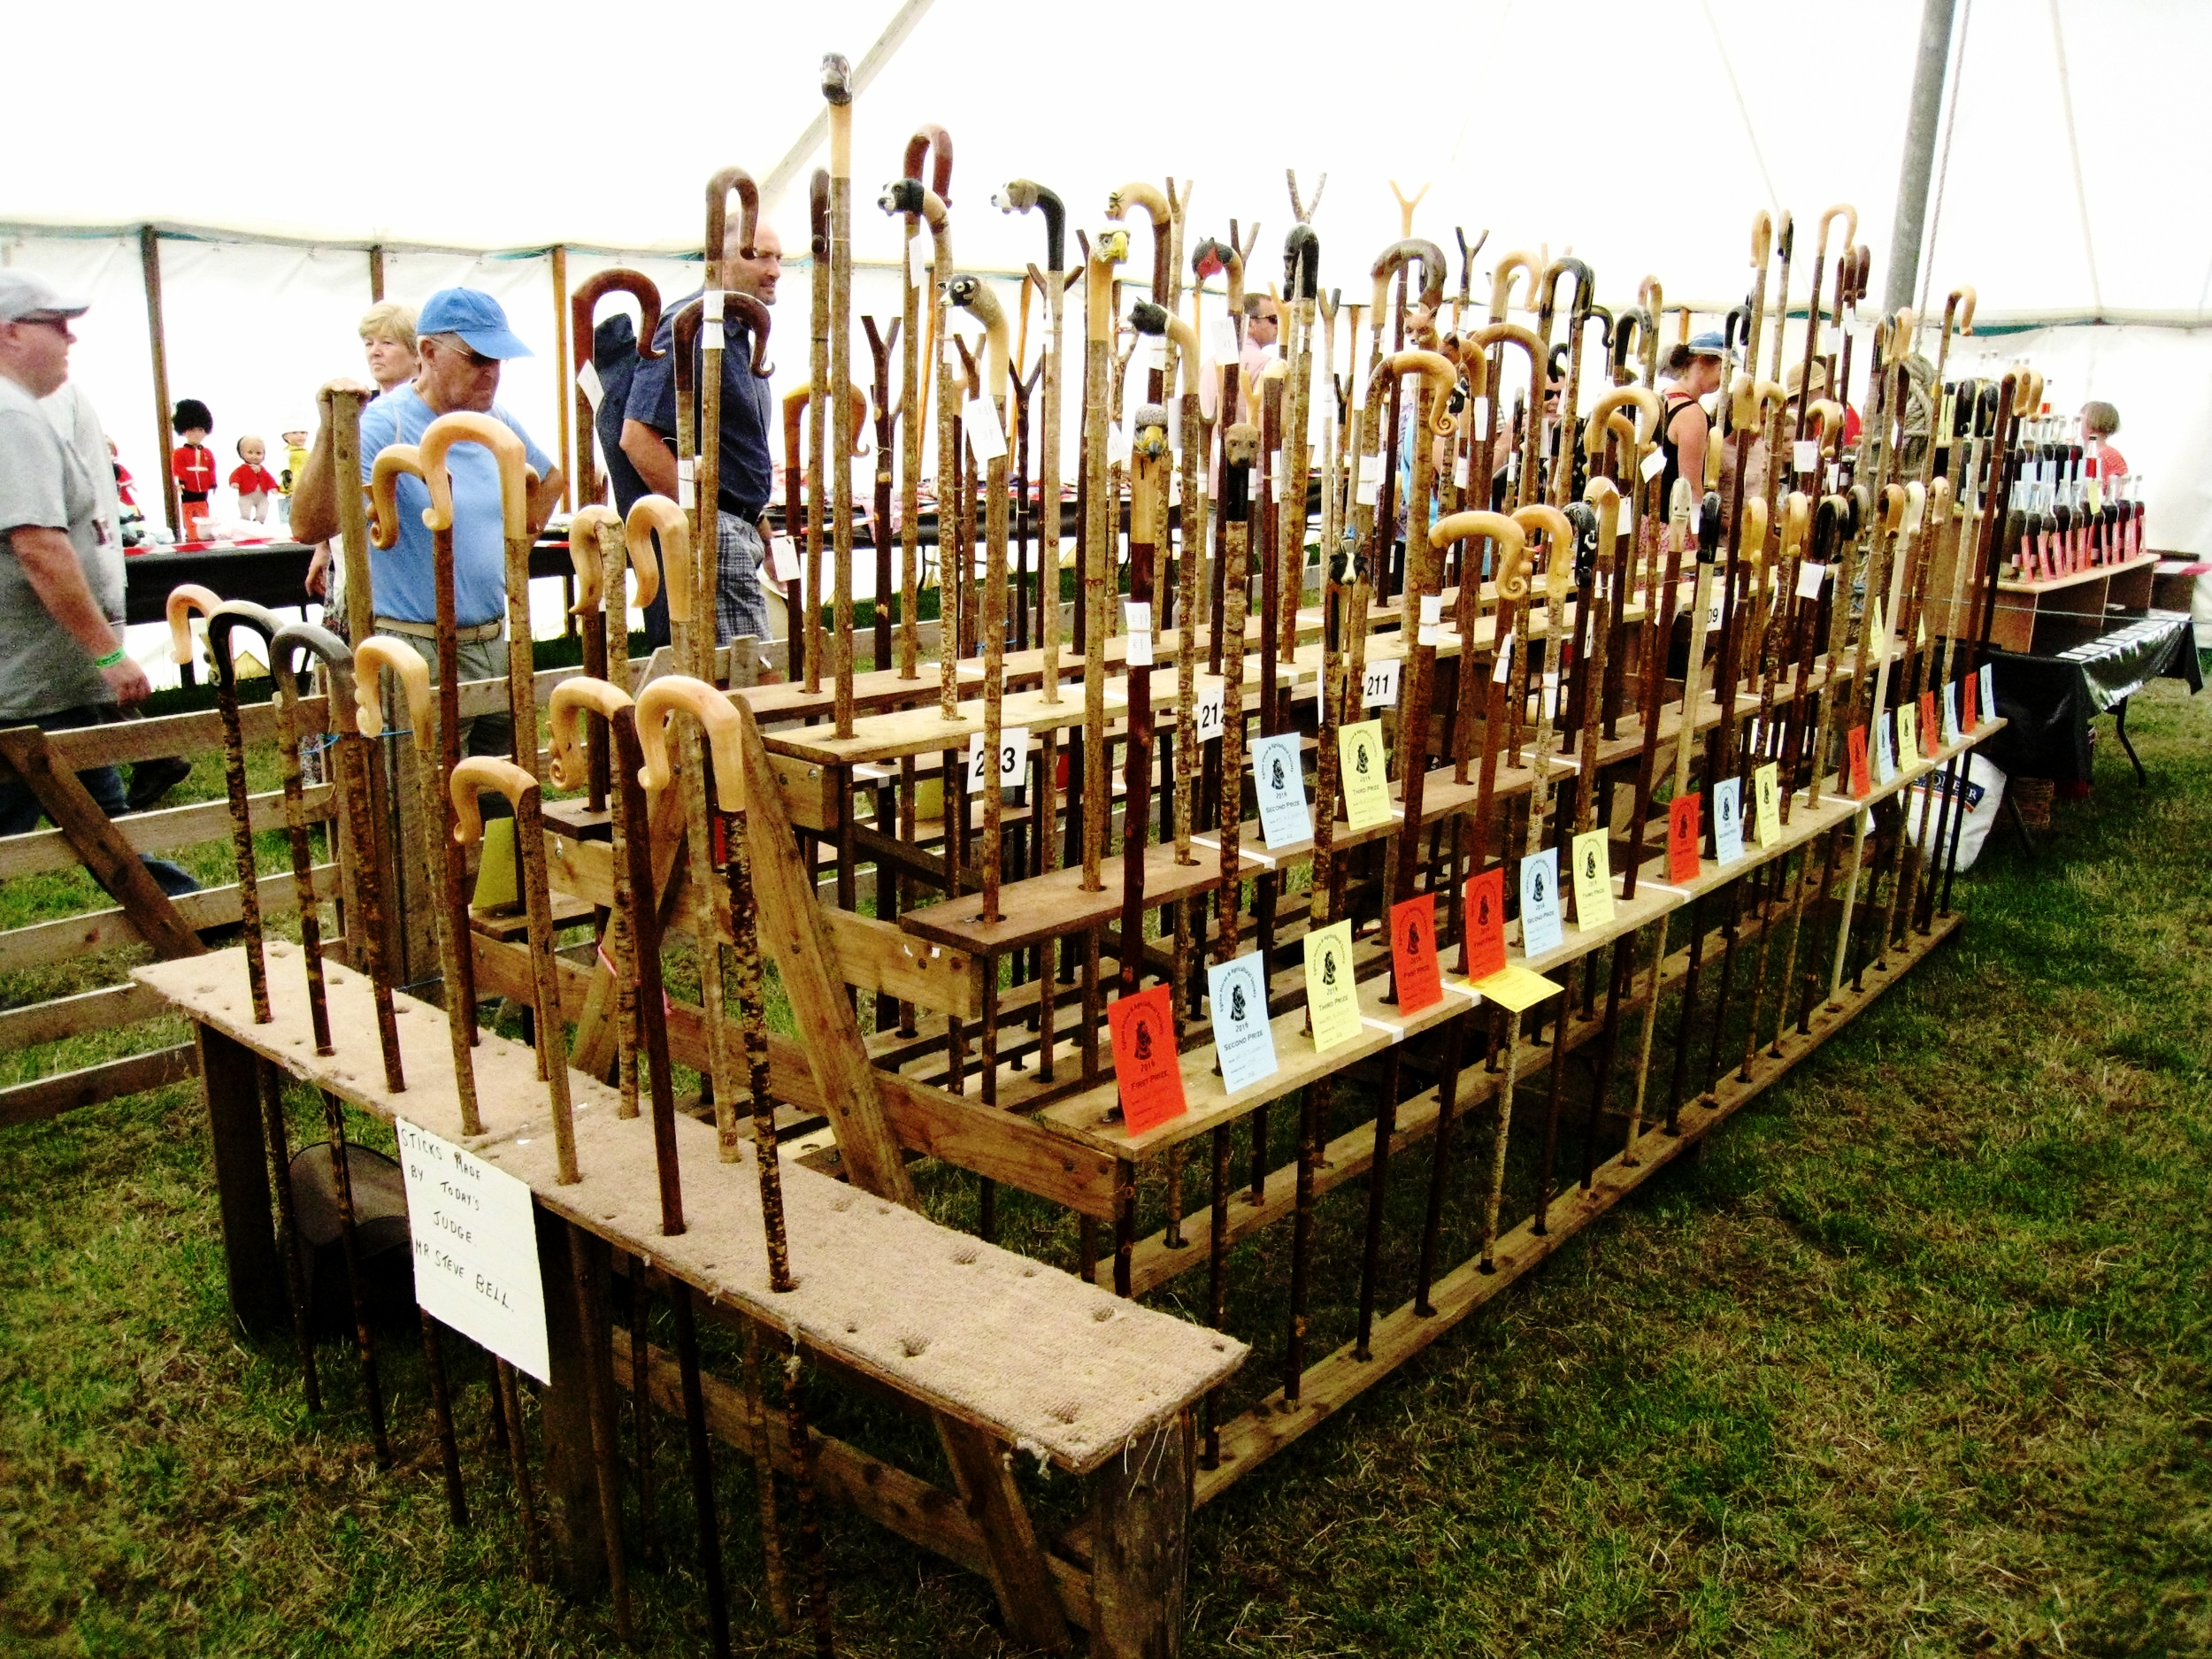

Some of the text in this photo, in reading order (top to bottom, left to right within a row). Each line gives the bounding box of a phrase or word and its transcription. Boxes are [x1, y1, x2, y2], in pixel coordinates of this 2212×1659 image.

[1367, 674, 1389, 696] 211
[975, 747, 1016, 778] 23
[1224, 1029, 1263, 1052] SECOND PRIZE
[1131, 1069, 1169, 1091] FIRST PRIZE
[401, 1129, 481, 1181] STICKS MADE
[411, 1164, 423, 1182] BY
[415, 1238, 429, 1259] MR
[435, 1249, 465, 1279] STEVE
